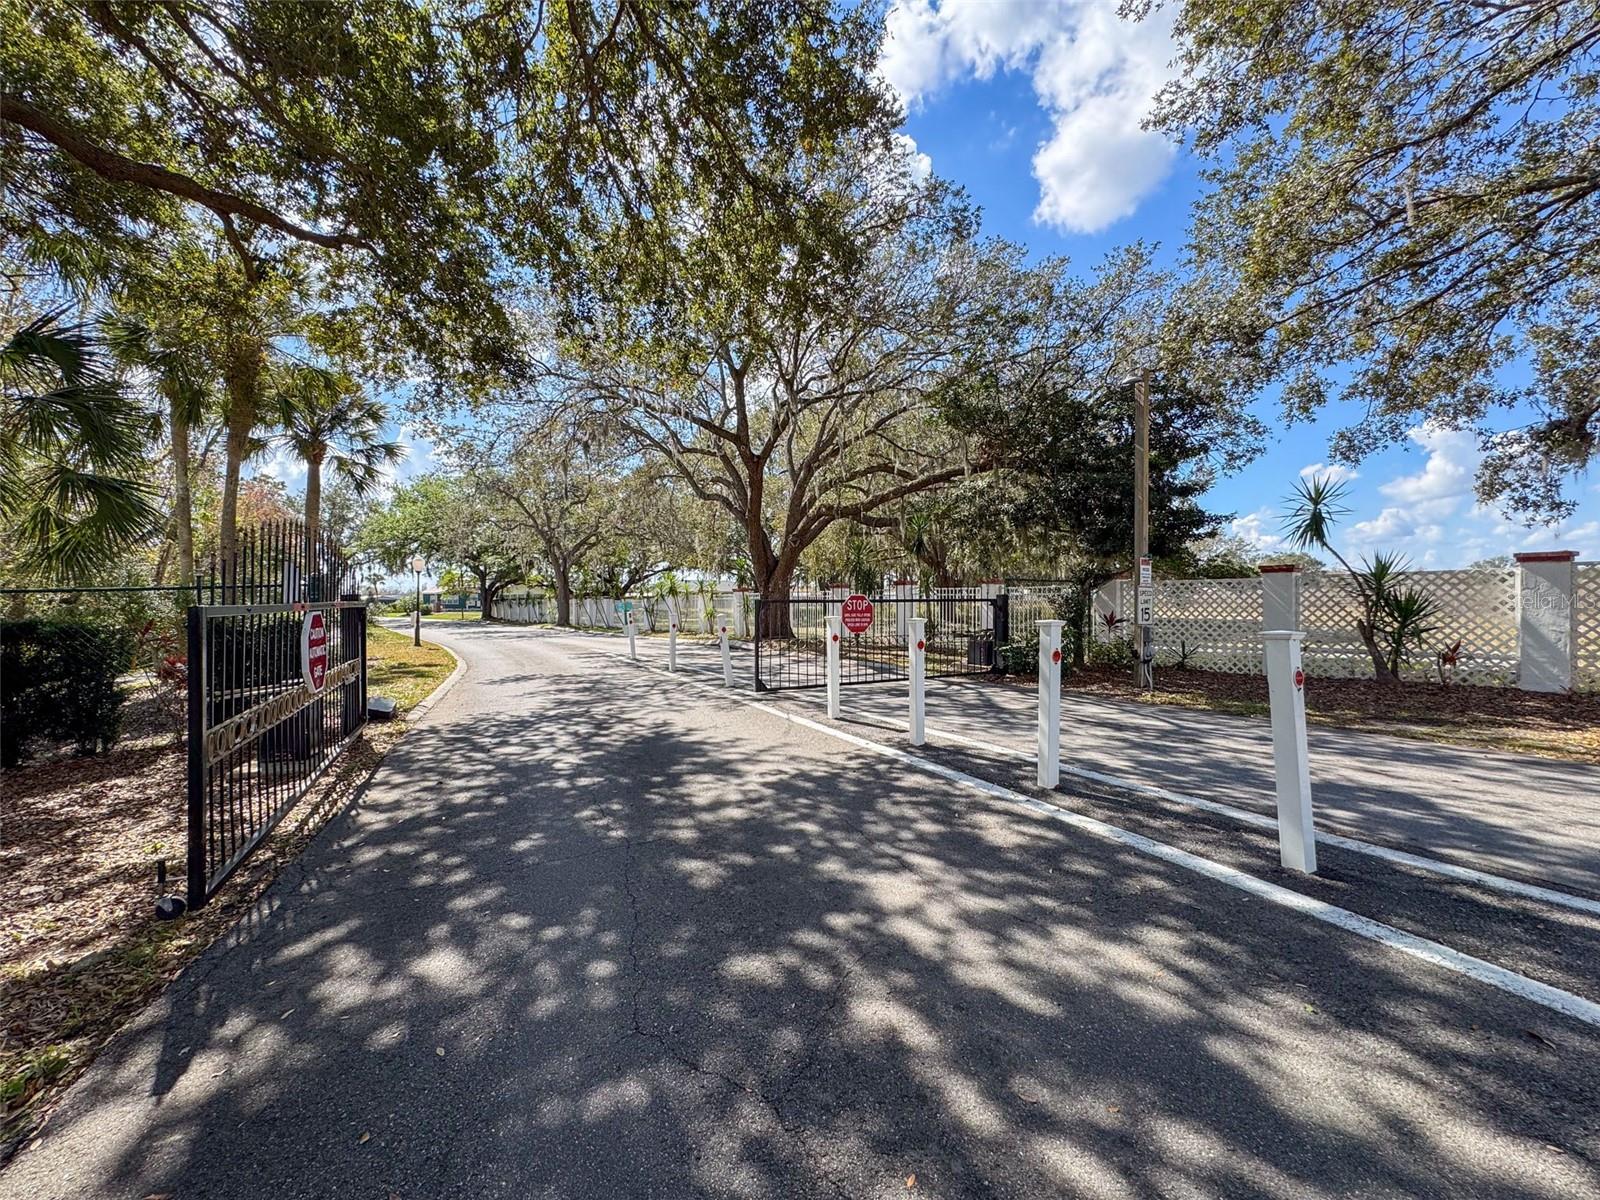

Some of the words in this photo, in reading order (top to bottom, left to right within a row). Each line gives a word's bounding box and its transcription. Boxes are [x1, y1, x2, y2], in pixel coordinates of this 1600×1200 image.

[847, 600, 869, 611] STOP
[1141, 607, 1151, 622] 15
[310, 627, 325, 640] CAUTION
[314, 665, 323, 678] GATE
